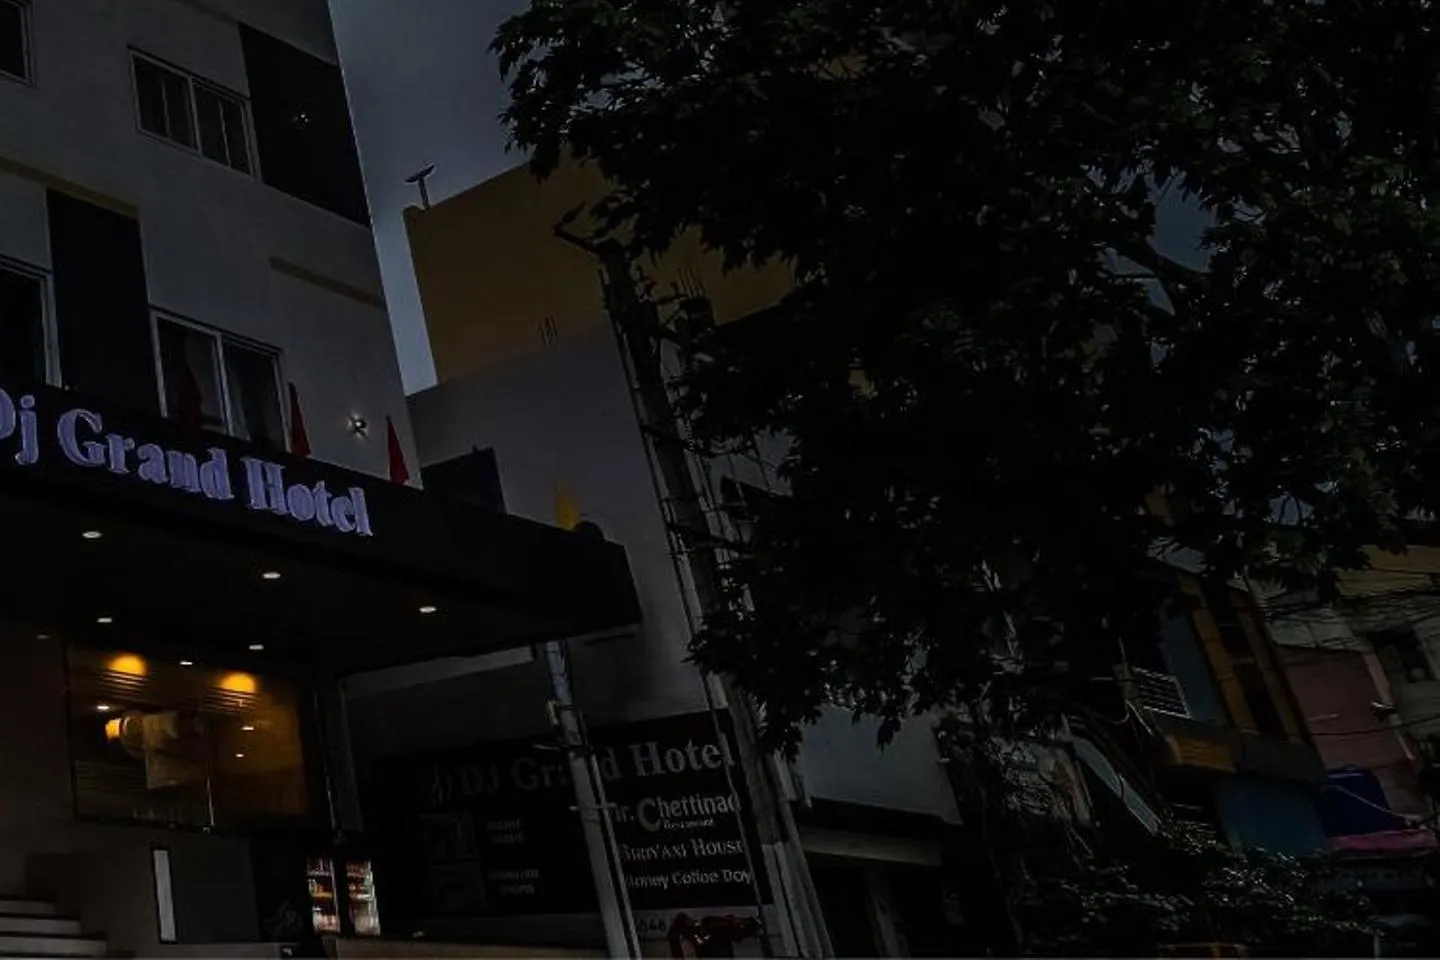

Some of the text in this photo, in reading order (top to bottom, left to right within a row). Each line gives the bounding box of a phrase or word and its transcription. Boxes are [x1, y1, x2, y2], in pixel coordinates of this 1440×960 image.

[57, 407, 234, 501] Grand
[241, 456, 374, 538] Hotel
[510, 744, 624, 792] Grd
[628, 736, 736, 778] Hotel
